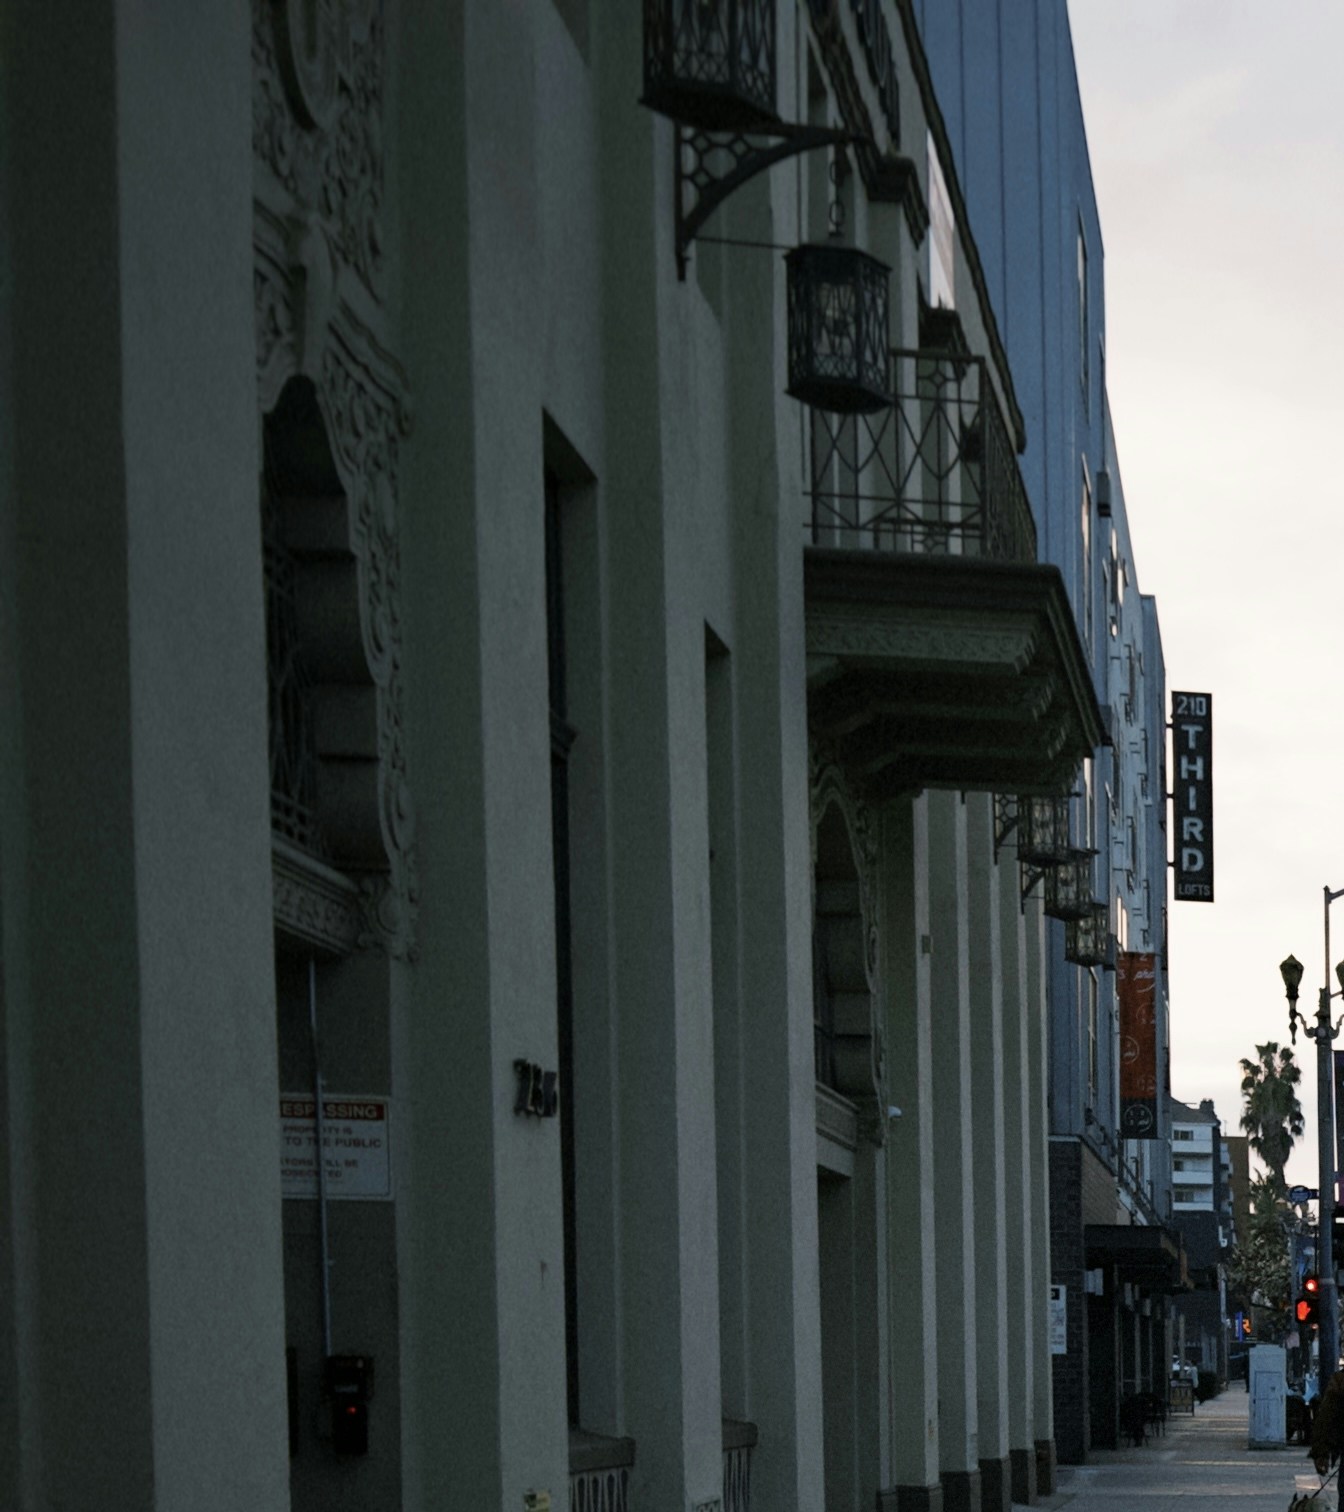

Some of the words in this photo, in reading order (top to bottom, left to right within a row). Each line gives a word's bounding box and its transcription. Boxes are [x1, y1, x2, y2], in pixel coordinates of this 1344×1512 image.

[1177, 696, 1207, 717] 210
[1180, 724, 1205, 873] THIRD
[1178, 883, 1211, 897] LOFTS
[282, 1103, 377, 1119] ESPSSING
[335, 1138, 382, 1149] PUBLIC
